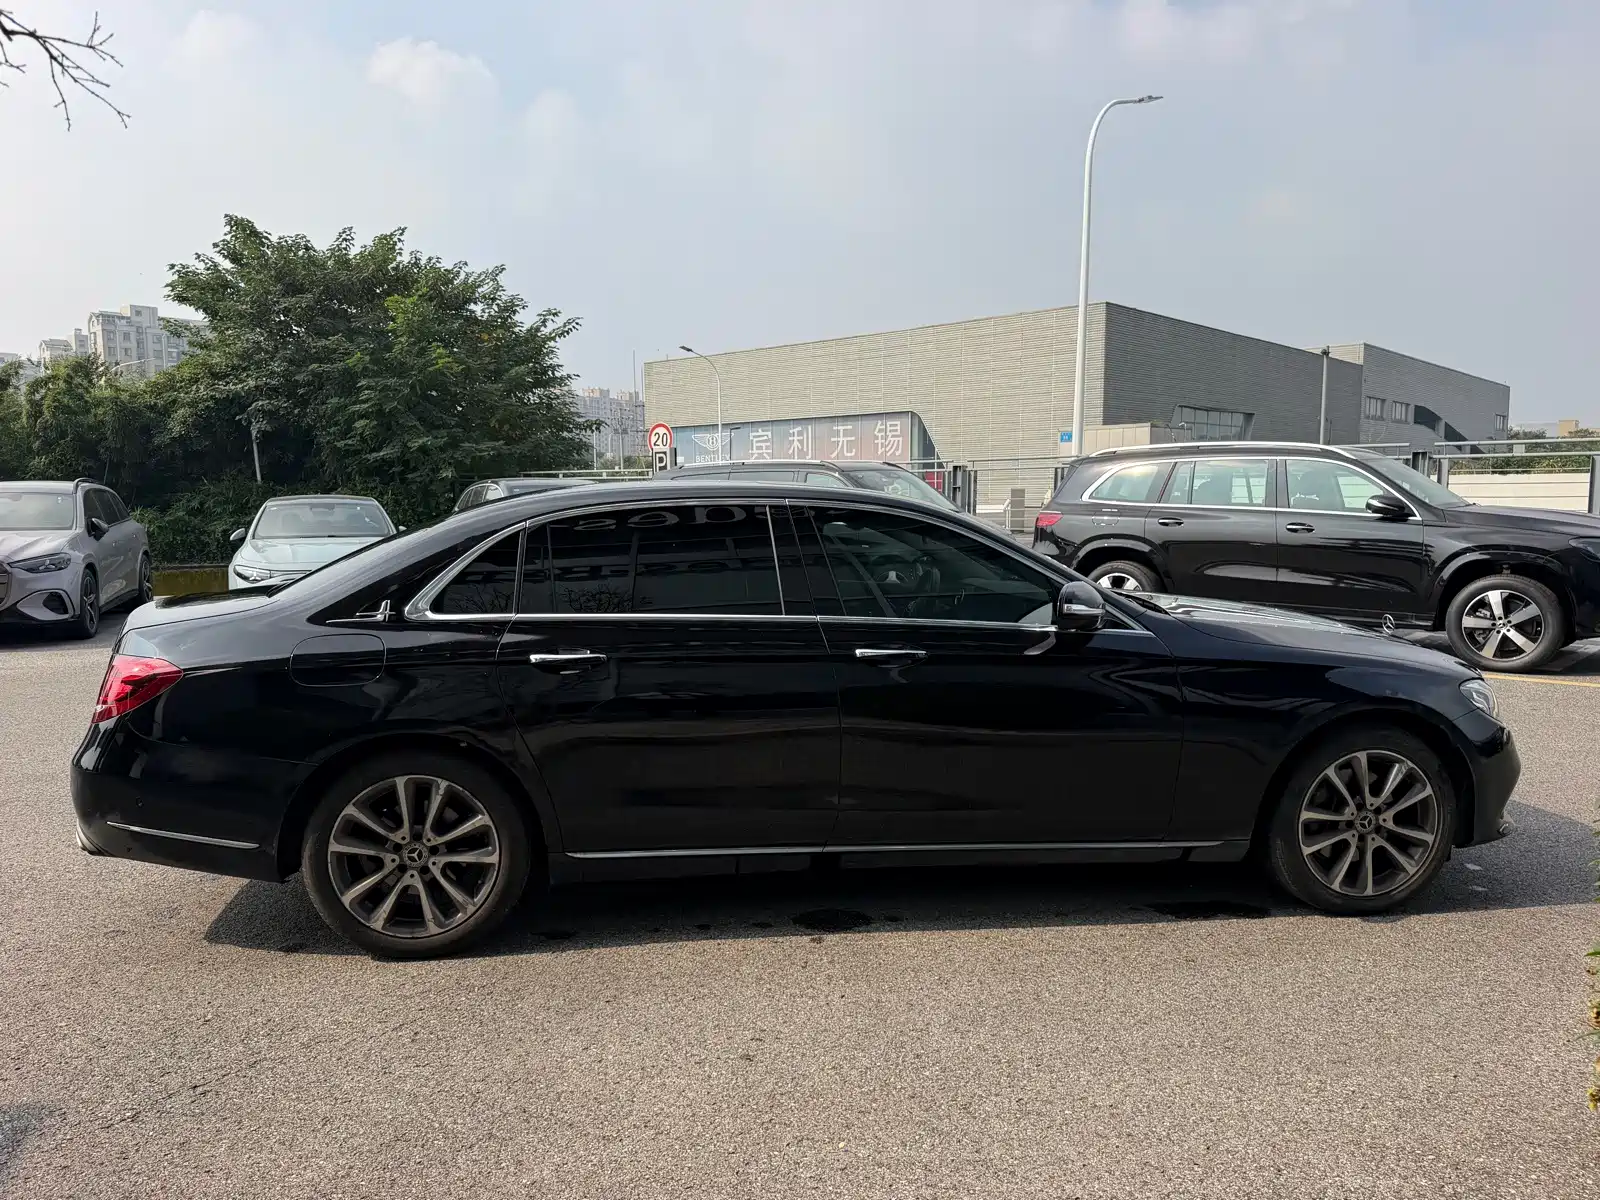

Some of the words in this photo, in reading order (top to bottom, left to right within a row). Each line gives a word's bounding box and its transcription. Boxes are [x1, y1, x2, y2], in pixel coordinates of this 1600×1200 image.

[653, 432, 668, 447] 20
[749, 420, 903, 461] 宾利无锡
[656, 453, 667, 472] P
